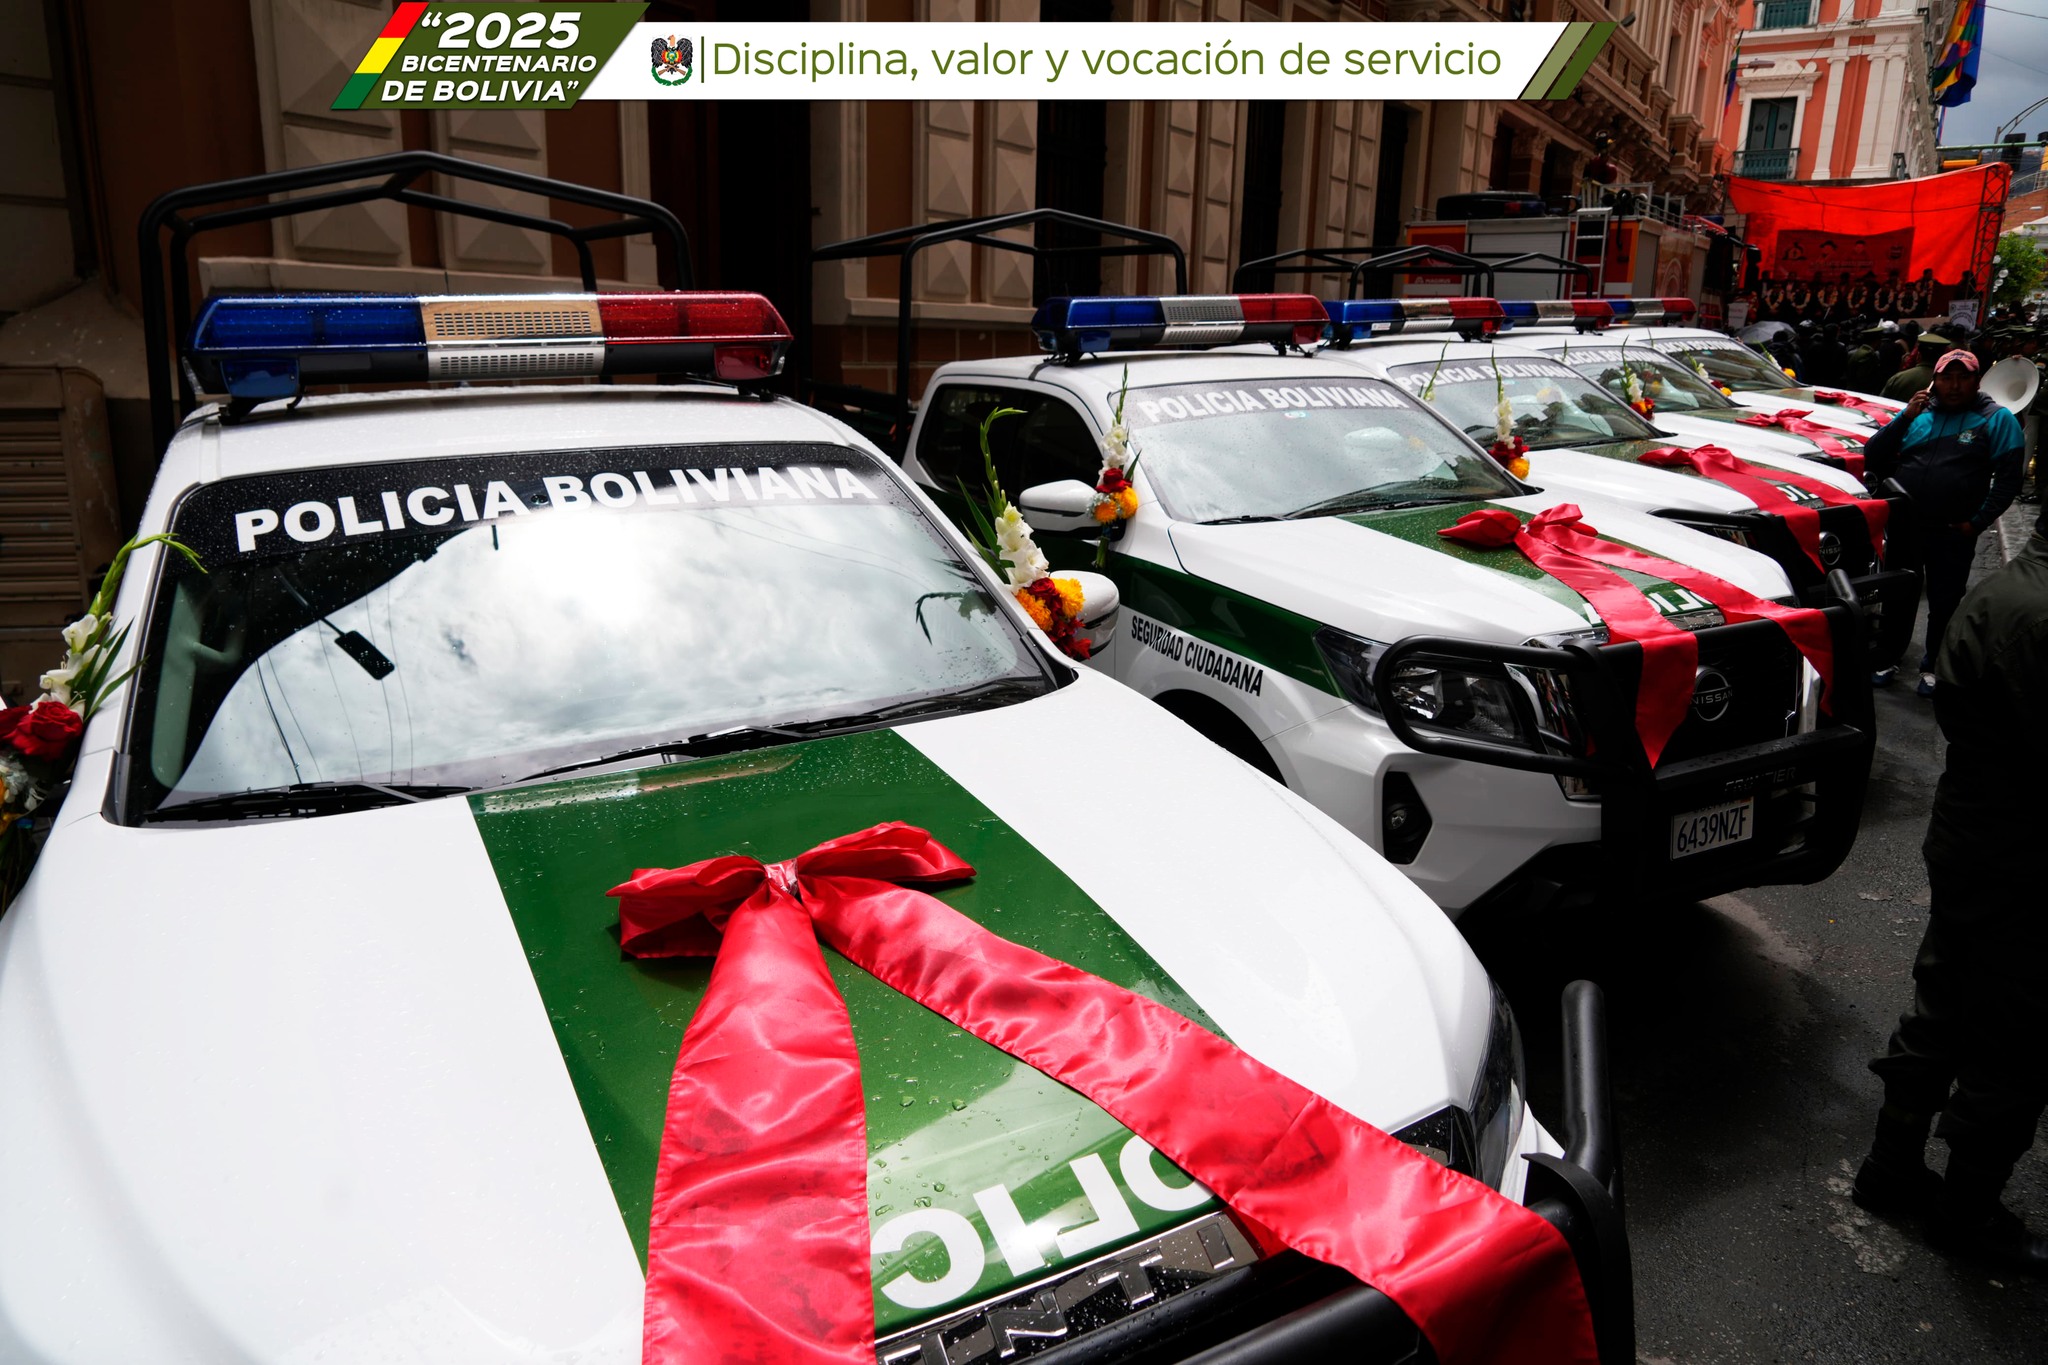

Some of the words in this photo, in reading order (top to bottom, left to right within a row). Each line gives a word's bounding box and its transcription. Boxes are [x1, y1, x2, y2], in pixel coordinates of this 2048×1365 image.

[1395, 366, 1486, 390] POLICIA
[1479, 364, 1583, 380] BOLIVIANA
[1137, 386, 1262, 424] POLICIA
[1259, 386, 1409, 411] BOLIVIANA
[235, 480, 533, 553] POLICIA
[542, 466, 878, 514] BOLIVIANA
[1131, 615, 1184, 662] SEGURIDAD
[1184, 641, 1264, 697] CIUDADANA
[1677, 804, 1750, 852] 6439NZF
